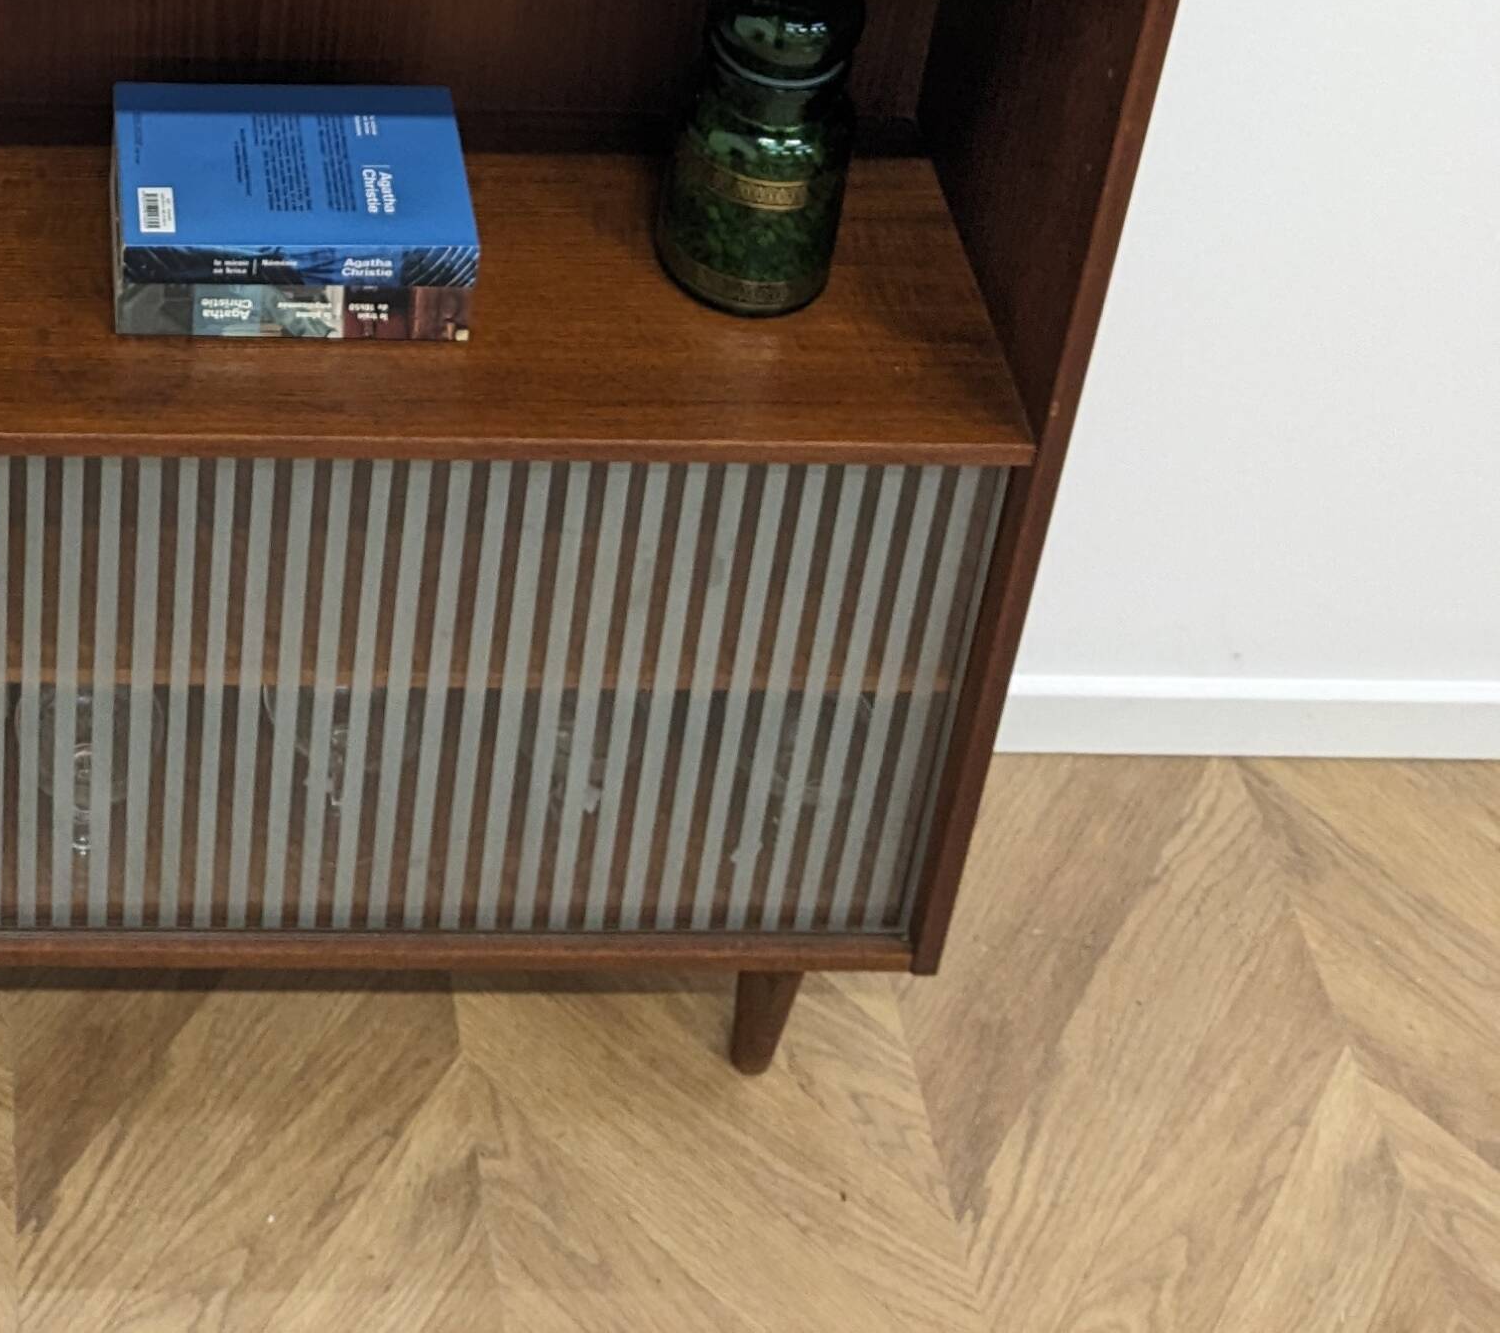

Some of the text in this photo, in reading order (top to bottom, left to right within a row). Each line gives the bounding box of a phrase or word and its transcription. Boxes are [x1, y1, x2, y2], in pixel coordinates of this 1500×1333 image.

[362, 168, 381, 214] Christie
[378, 171, 397, 214] Agatha
[344, 258, 393, 270] Agatha
[342, 268, 393, 278] Christie
[201, 298, 253, 310] Christie
[202, 309, 250, 321] Agatha
